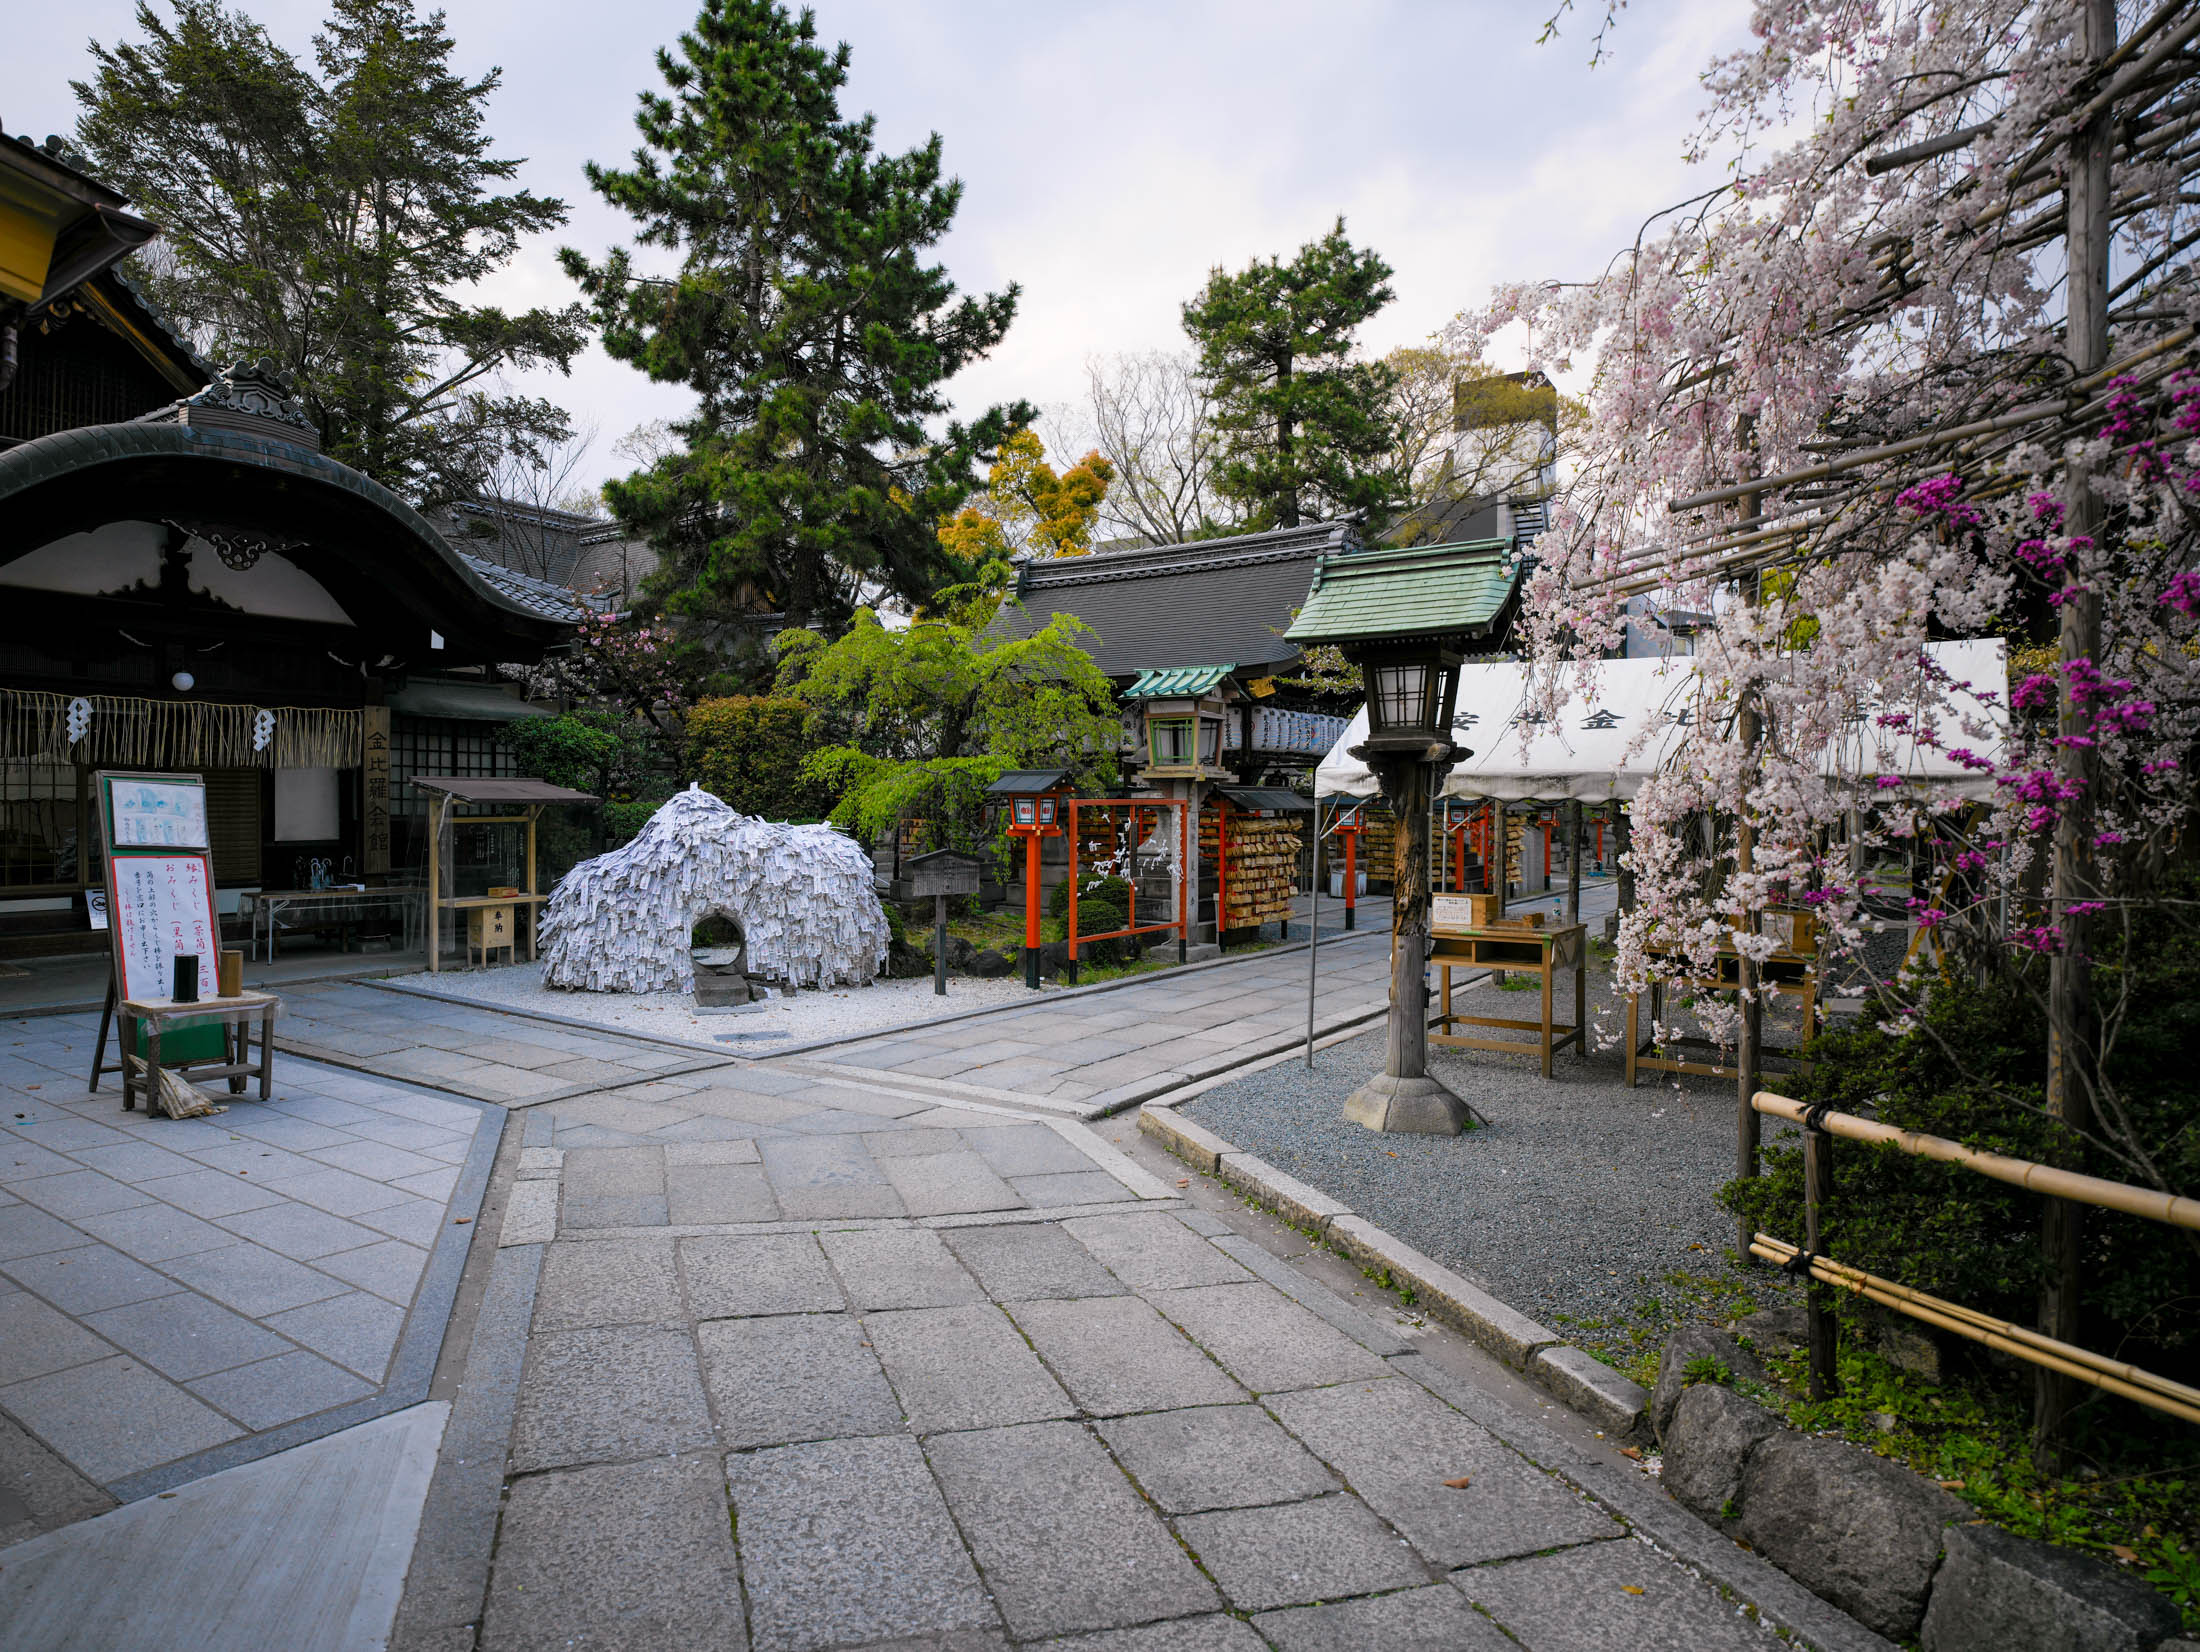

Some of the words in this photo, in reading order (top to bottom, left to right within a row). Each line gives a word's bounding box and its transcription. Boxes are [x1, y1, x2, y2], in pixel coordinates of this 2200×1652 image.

[367, 731, 389, 851] 金比羅会館
[166, 864, 180, 911] おみくじ
[494, 910, 503, 933] 奉納
